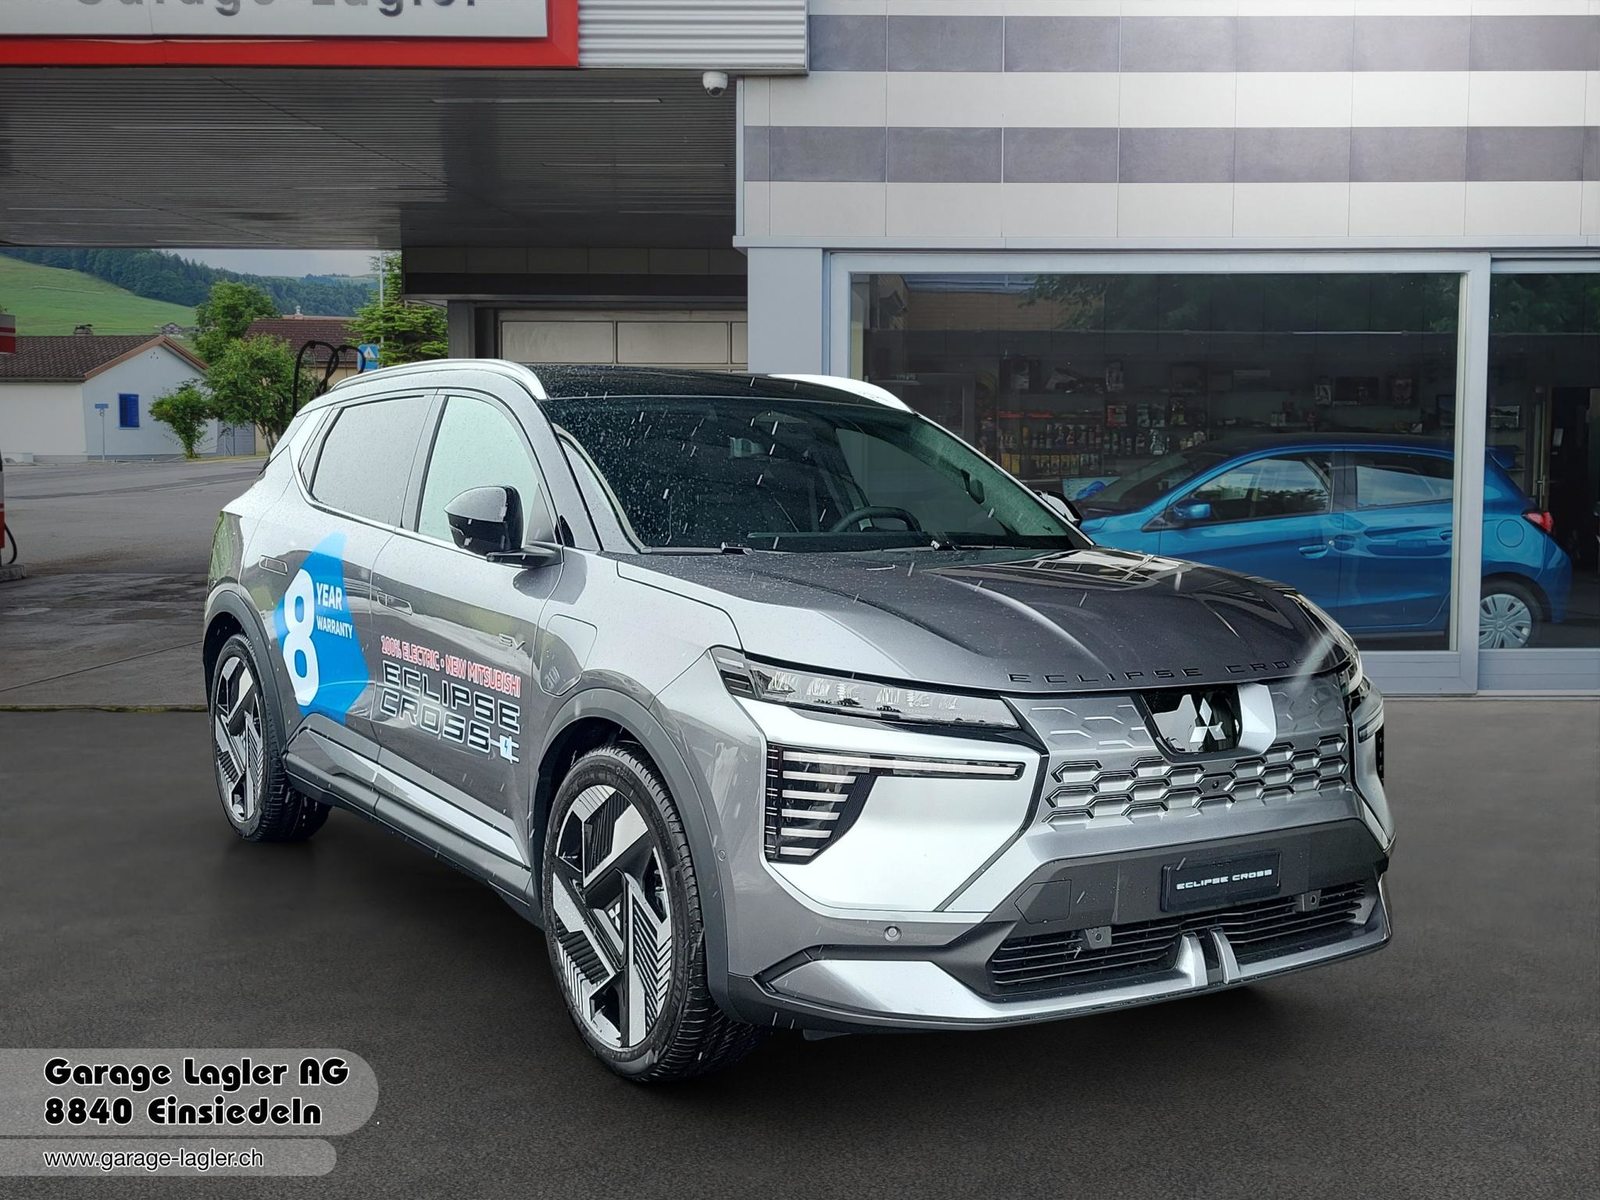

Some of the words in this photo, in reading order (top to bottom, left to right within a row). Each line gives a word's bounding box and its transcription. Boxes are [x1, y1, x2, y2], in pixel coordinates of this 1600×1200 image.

[316, 582, 343, 610] YEAR
[283, 568, 319, 706] 8
[316, 615, 353, 639] WARRANTY
[381, 635, 402, 659] 100%
[401, 641, 440, 671] ELECTRIC
[445, 654, 467, 680] NEW
[468, 661, 521, 698] MITSUBISHI
[1007, 667, 1204, 684] ECLIPSE
[383, 660, 520, 734] ECLIPSE
[380, 688, 491, 753] CROSS
[1176, 876, 1229, 890] ECLIPSE
[1232, 869, 1273, 881] CROSS
